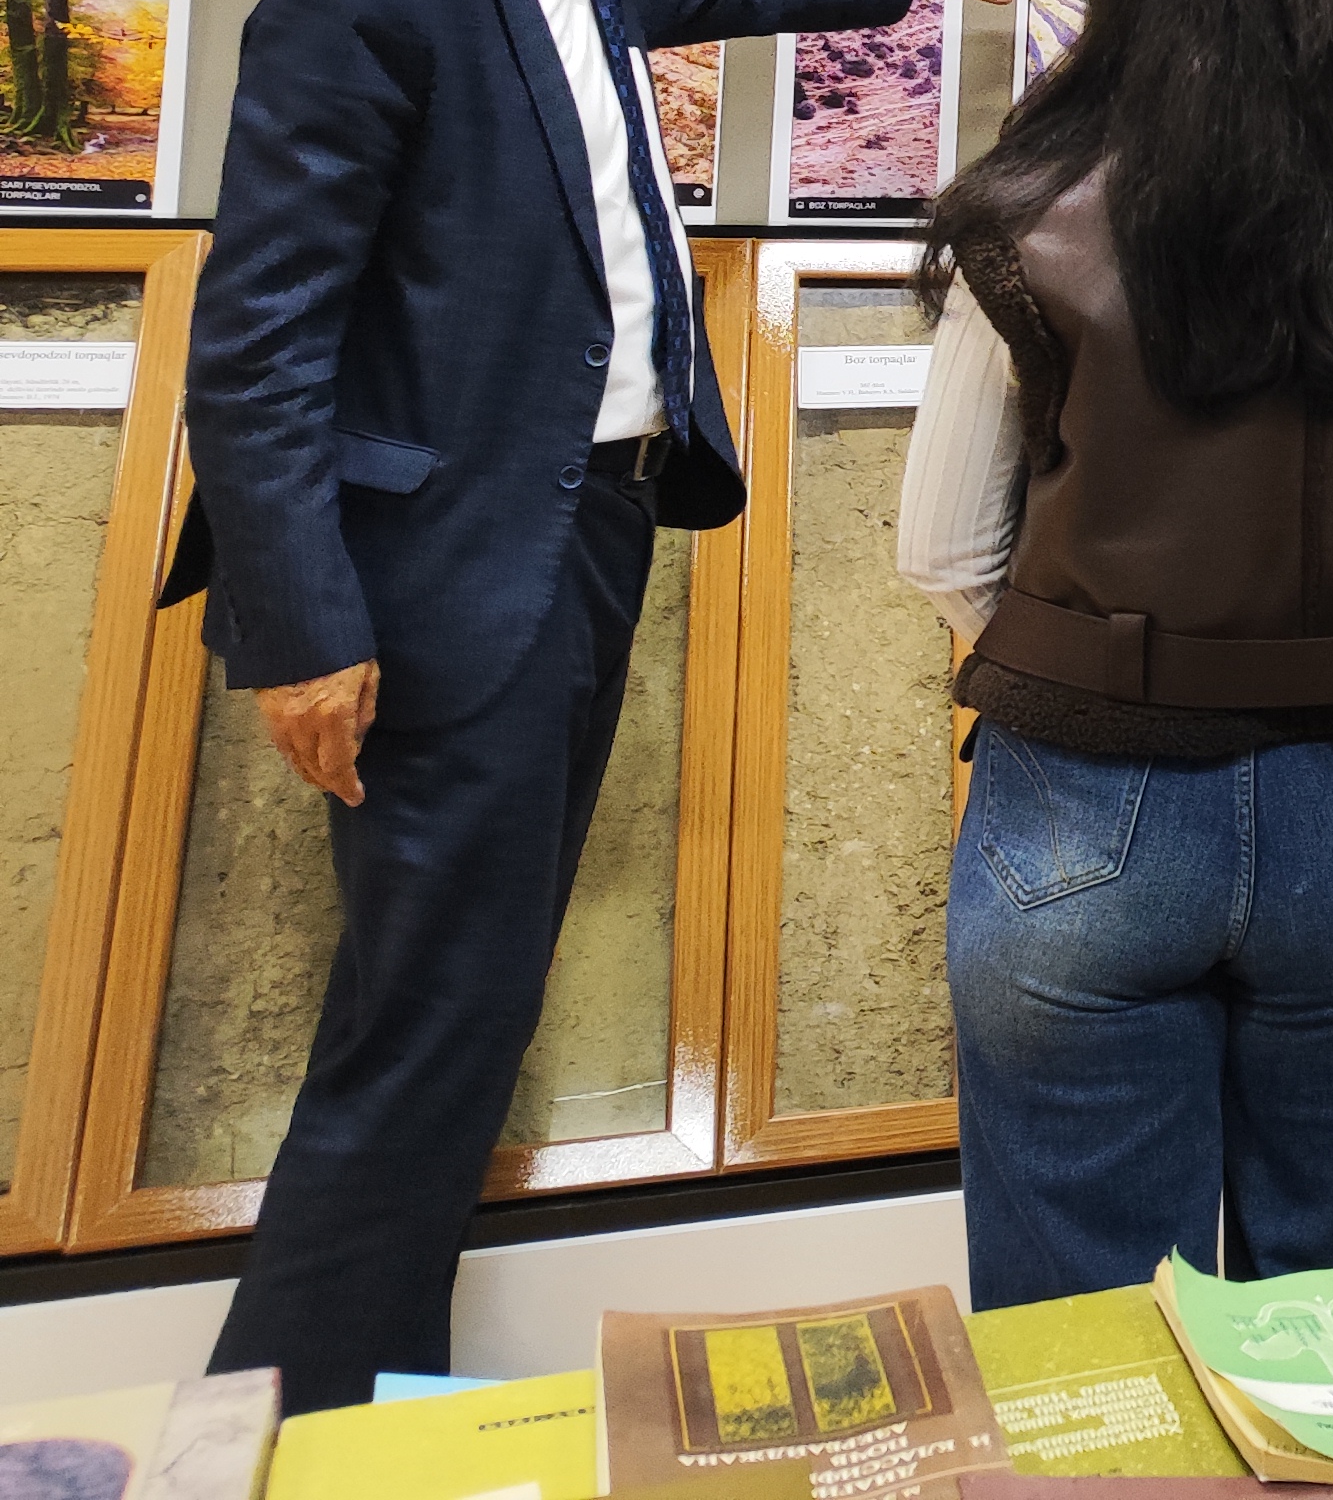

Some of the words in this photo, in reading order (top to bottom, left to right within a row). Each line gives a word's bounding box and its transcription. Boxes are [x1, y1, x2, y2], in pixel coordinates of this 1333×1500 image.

[0, 351, 71, 361] sevdopodzol
[75, 351, 127, 362] torpaqlar
[844, 355, 865, 364] Boz
[869, 354, 918, 366] torpaqlar
[828, 1435, 909, 1467] ПОЧВ
